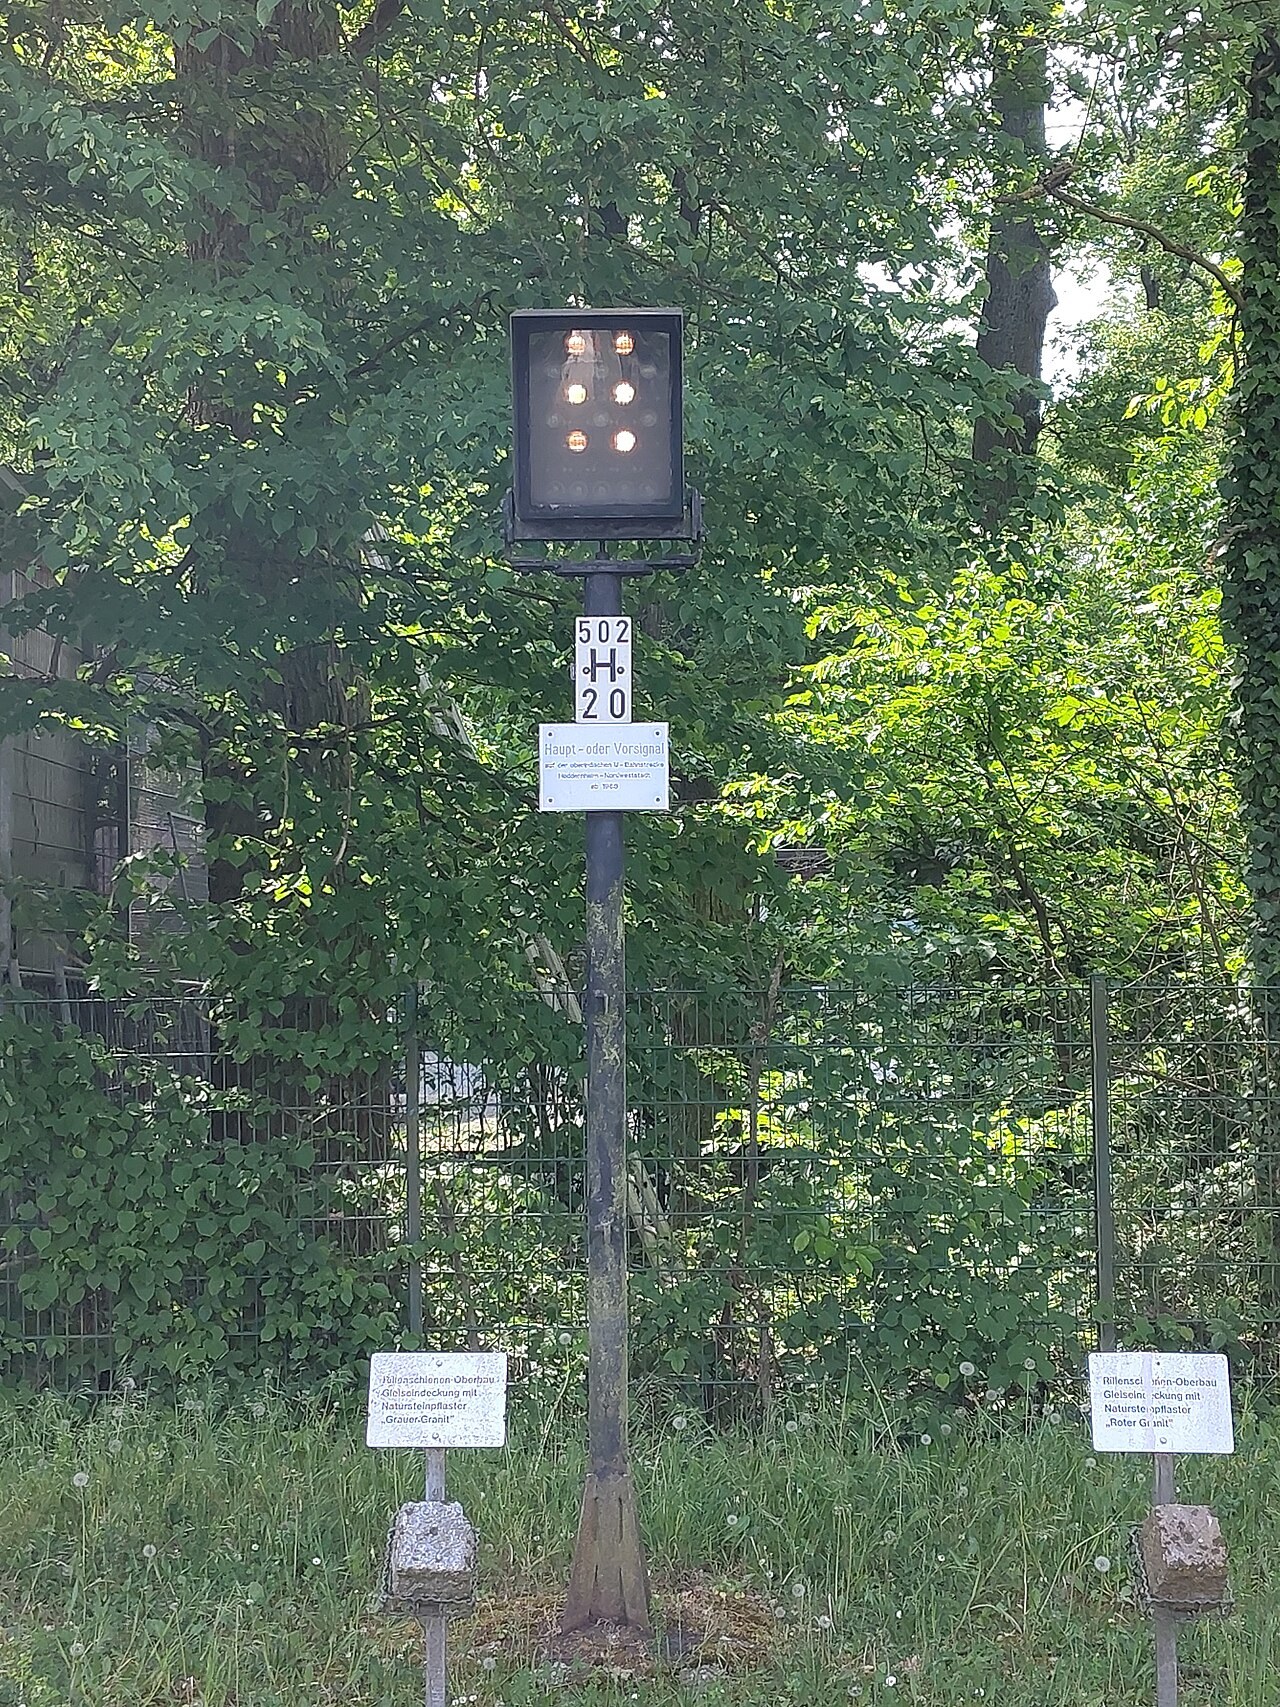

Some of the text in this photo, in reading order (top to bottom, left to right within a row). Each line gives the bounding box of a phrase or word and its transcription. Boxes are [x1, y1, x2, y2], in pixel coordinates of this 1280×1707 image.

[578, 620, 629, 644] 502
[582, 688, 626, 719] 20
[586, 742, 611, 755] oder
[613, 742, 665, 757] Vorsignal
[1103, 1376, 1217, 1387] Rillenscnen-Oberbau
[382, 1388, 478, 1399] Gleiseindeckung mit
[1103, 1390, 1201, 1401] Gleiseinckung mit
[381, 1402, 467, 1411] Natursteinpflaster
[1104, 1404, 1192, 1416] Naturstepflaster
